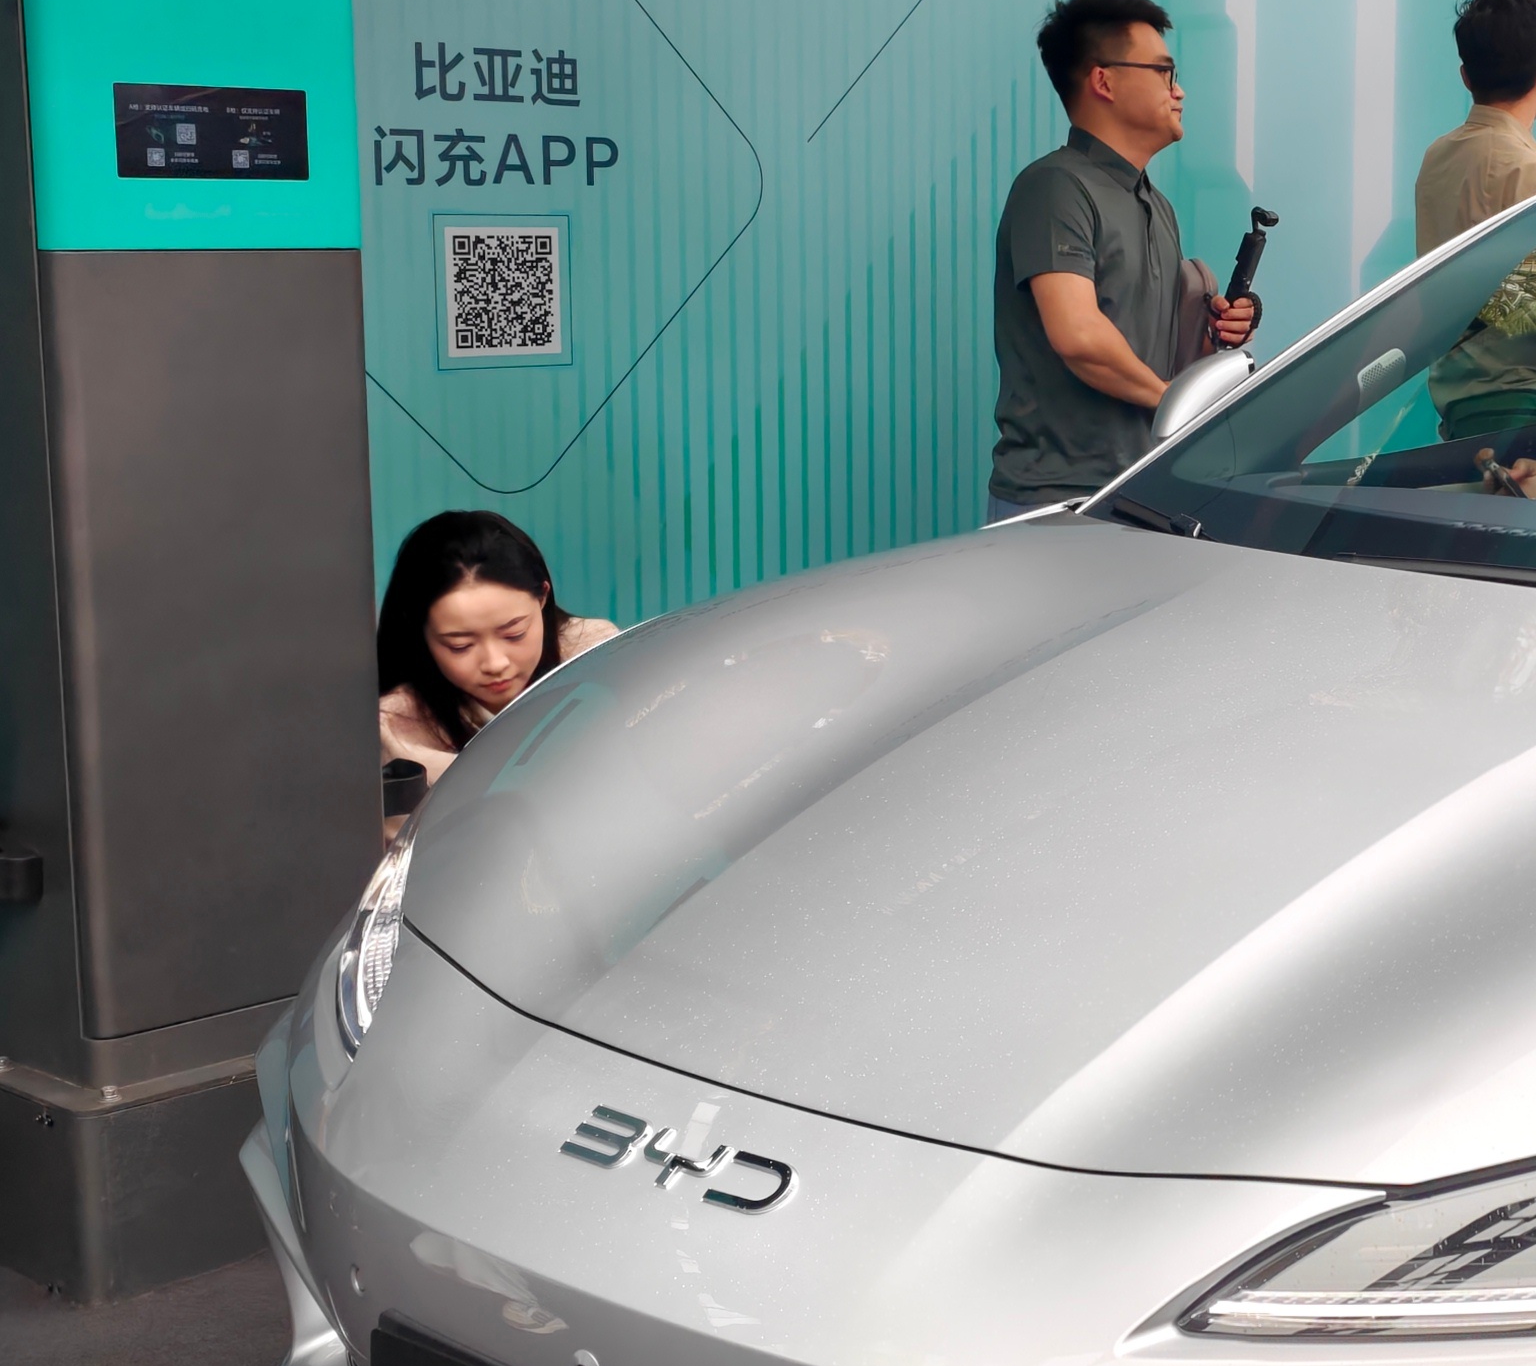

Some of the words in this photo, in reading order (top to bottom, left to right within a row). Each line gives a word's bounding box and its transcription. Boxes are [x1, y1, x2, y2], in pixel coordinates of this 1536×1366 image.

[414, 41, 581, 107] 比亚迪
[373, 125, 619, 187] 闪充APP
[557, 1102, 801, 1216] BYD
